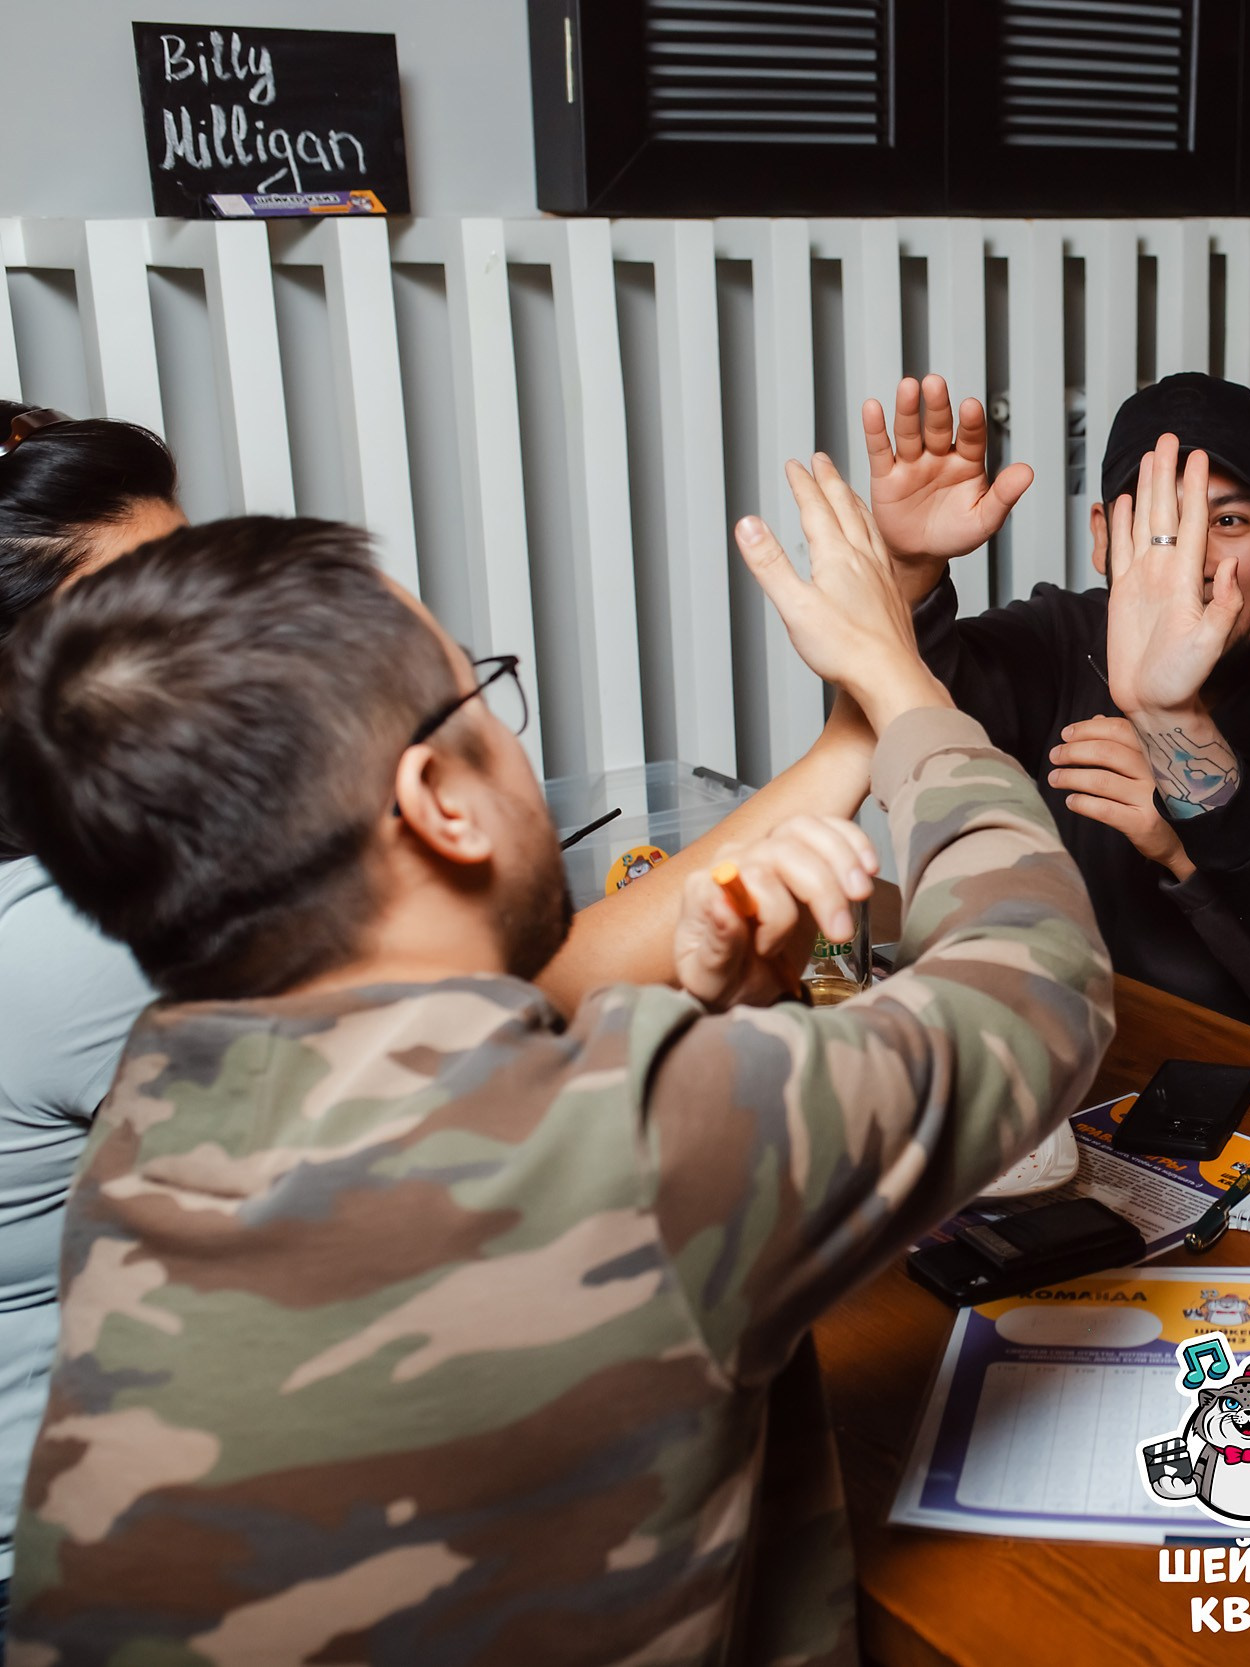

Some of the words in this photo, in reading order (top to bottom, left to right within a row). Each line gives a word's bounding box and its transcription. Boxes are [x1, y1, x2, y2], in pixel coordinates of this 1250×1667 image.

[159, 30, 276, 105] Billy
[159, 104, 366, 193] Milligan
[1076, 1123, 1113, 1142] ПРАВ
